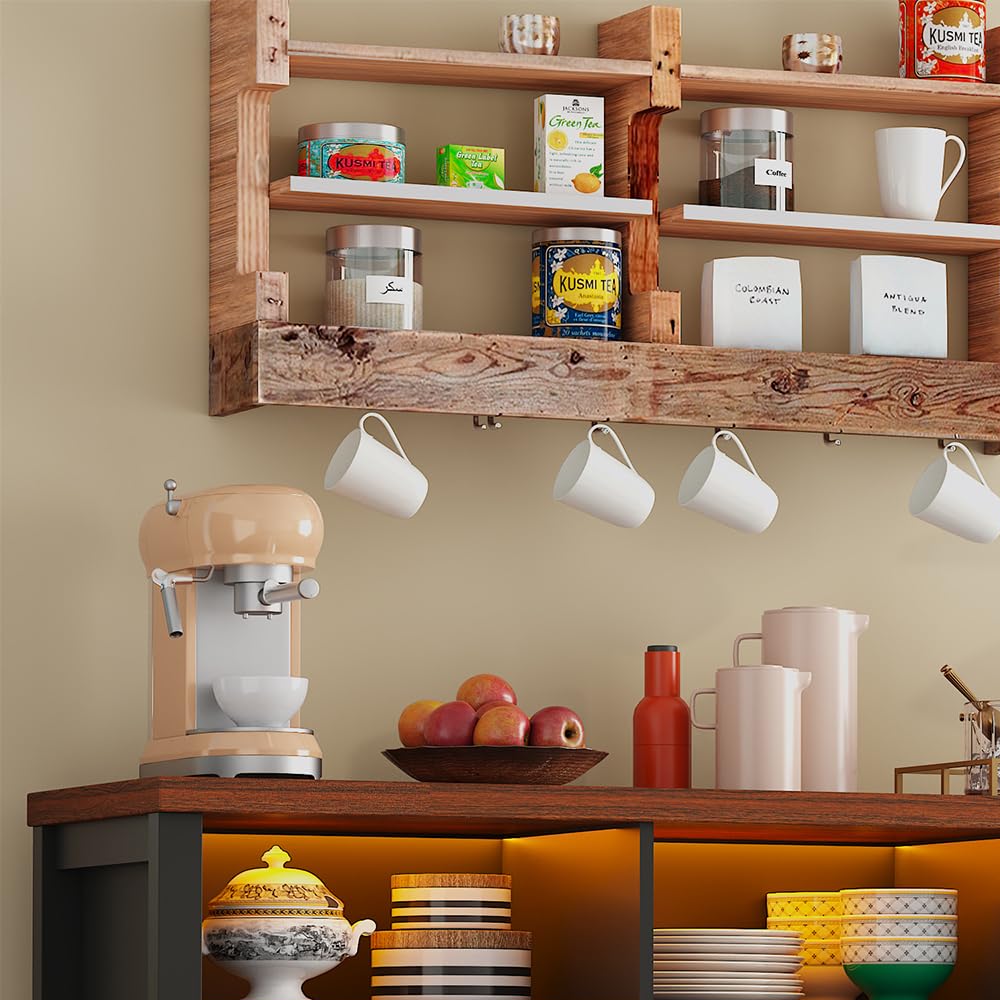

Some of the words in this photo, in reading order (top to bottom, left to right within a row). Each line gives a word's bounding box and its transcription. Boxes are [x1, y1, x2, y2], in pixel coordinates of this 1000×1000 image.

[929, 27, 966, 45] KUSMI
[968, 31, 983, 48] TEA
[549, 115, 582, 128] Green
[582, 116, 601, 130] Tea
[456, 150, 476, 160] Green
[477, 152, 498, 162] Label
[335, 157, 376, 169] KUSMI
[471, 160, 483, 168] Tea
[766, 169, 787, 177] Coffee
[560, 275, 598, 293] KUSMI
[600, 279, 617, 296] TEA
[735, 283, 790, 296] COLOMBIAN
[883, 292, 927, 303] ANTIGUA
[891, 305, 925, 315] BLEND
